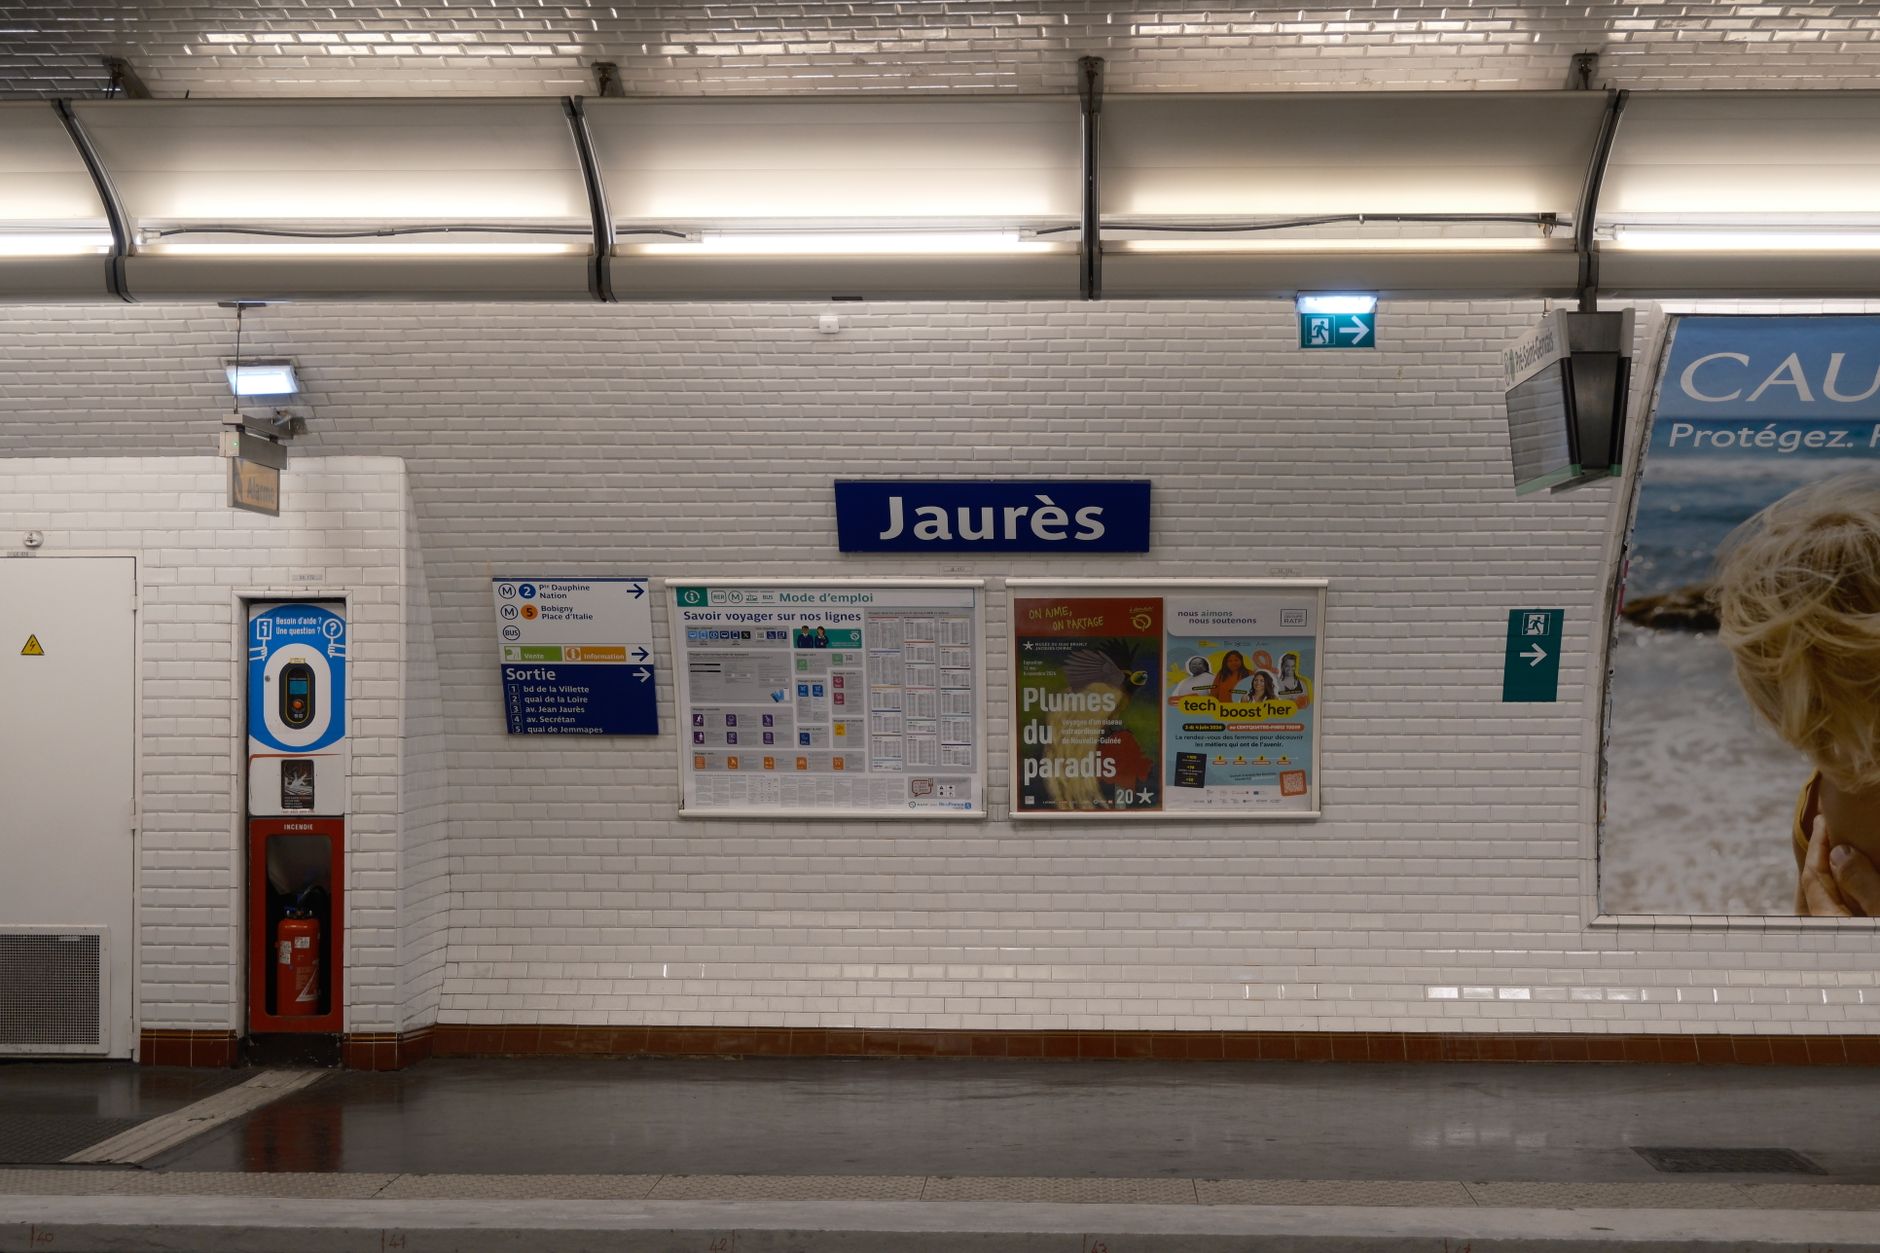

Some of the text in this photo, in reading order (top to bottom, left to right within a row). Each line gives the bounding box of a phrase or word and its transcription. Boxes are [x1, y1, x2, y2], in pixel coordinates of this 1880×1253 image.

[1669, 423, 1855, 454] Protégez.
[879, 494, 1106, 541] Jaurès
[523, 585, 533, 599] 2
[551, 584, 591, 593] Dauphine
[539, 592, 568, 600] Nation
[779, 592, 816, 602] Mode
[820, 591, 874, 605] d'emploi
[541, 605, 574, 613] Bobigny
[1028, 609, 1042, 620] ON
[275, 616, 295, 625] Besoin
[297, 616, 317, 625] d'aide
[683, 610, 722, 621] Savoir
[725, 612, 774, 624] voyager
[776, 612, 796, 621] sur
[799, 612, 822, 621] nos
[825, 611, 861, 624] lignes
[1052, 616, 1105, 631] ON PARTAGE
[275, 626, 288, 635] Une
[288, 626, 316, 636] question
[506, 667, 557, 681] Sortie
[523, 685, 535, 693] bd
[536, 685, 548, 693] de
[558, 685, 590, 693] Villette
[524, 696, 543, 704] quai
[1023, 687, 1117, 712] Plumes
[1183, 699, 1217, 711] tech
[559, 705, 585, 713] Jaurès
[539, 715, 576, 723] Secrétan
[527, 726, 546, 734] quai
[559, 726, 604, 734] Jemmapes
[1023, 719, 1054, 745] du
[1228, 741, 1239, 749] qui
[1023, 751, 1117, 786] paradis
[1116, 789, 1134, 804] 20
[283, 823, 313, 831] INCENDIE
